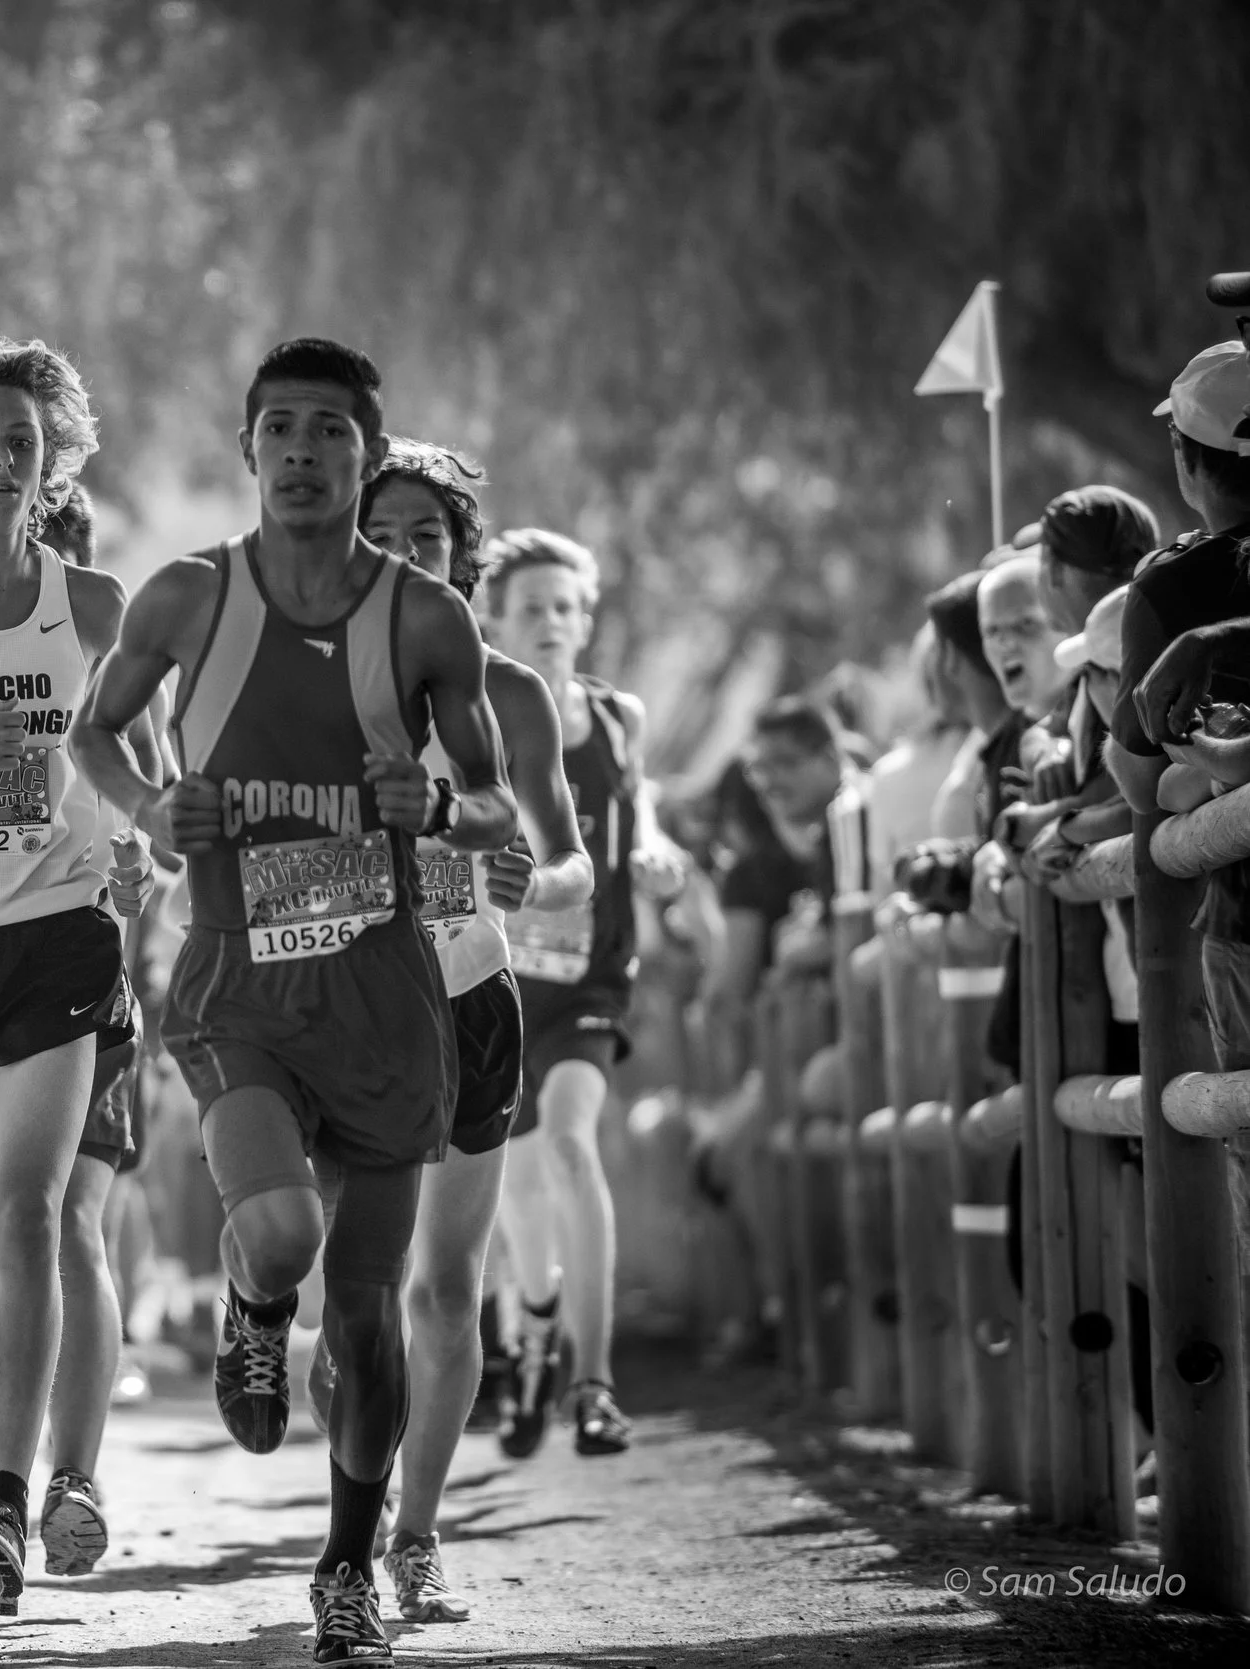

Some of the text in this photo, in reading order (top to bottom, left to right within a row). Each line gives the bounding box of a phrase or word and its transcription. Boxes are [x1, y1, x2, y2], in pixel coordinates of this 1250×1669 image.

[223, 777, 362, 838] CORONA
[271, 887, 312, 917] XC
[311, 878, 375, 905] INVITE
